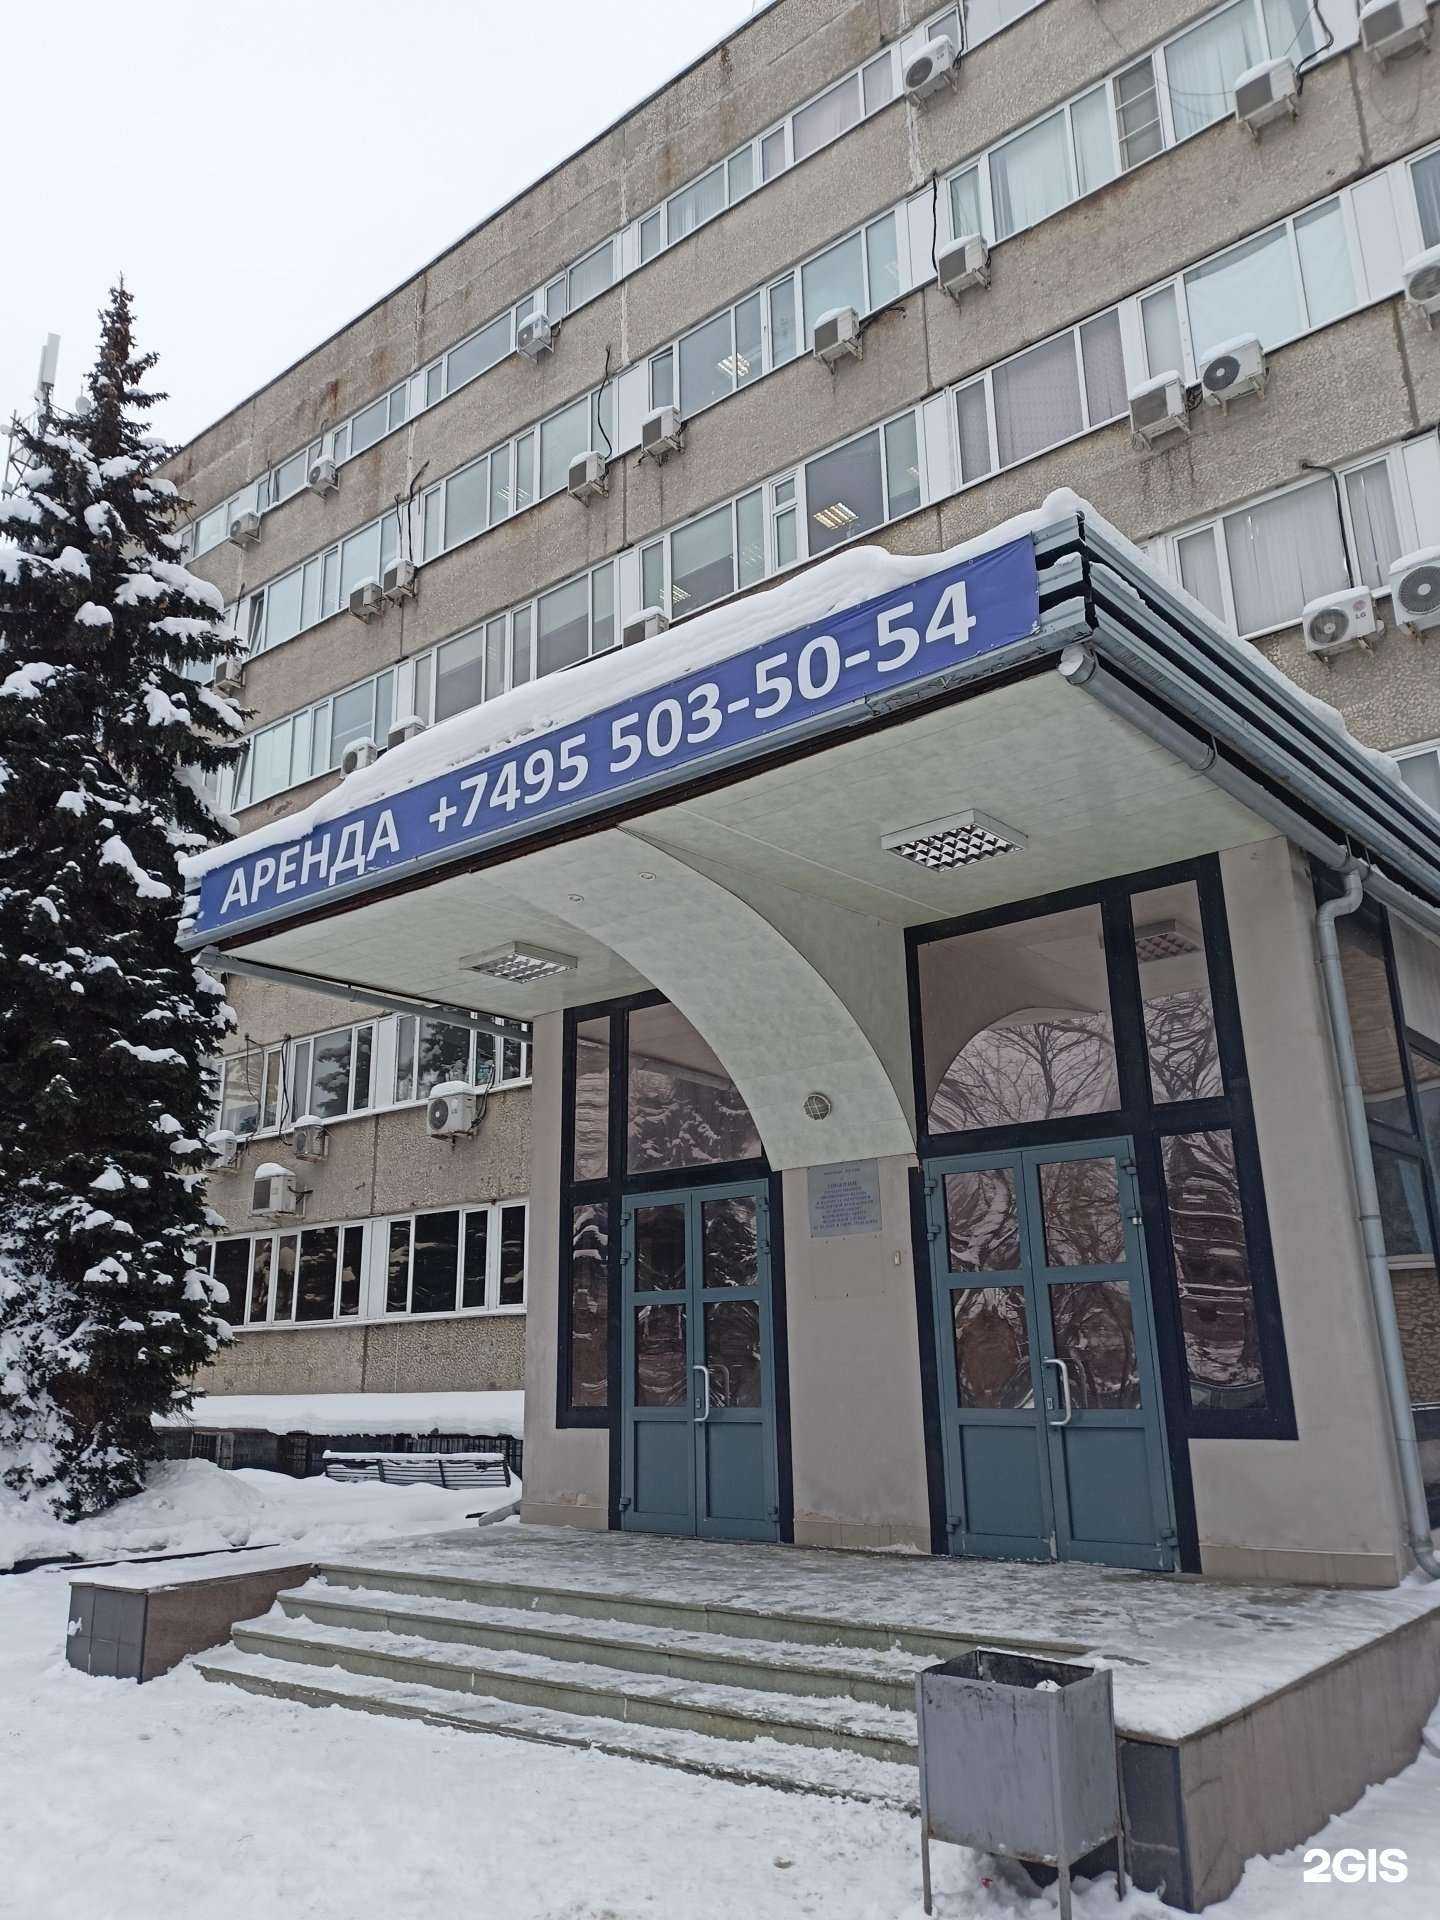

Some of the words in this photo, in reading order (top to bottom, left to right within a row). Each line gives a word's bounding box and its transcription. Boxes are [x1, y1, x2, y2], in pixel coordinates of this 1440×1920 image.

[219, 808, 400, 914] АРЕНДА
[428, 733, 588, 833] +7495
[609, 580, 977, 773] 503-50-54
